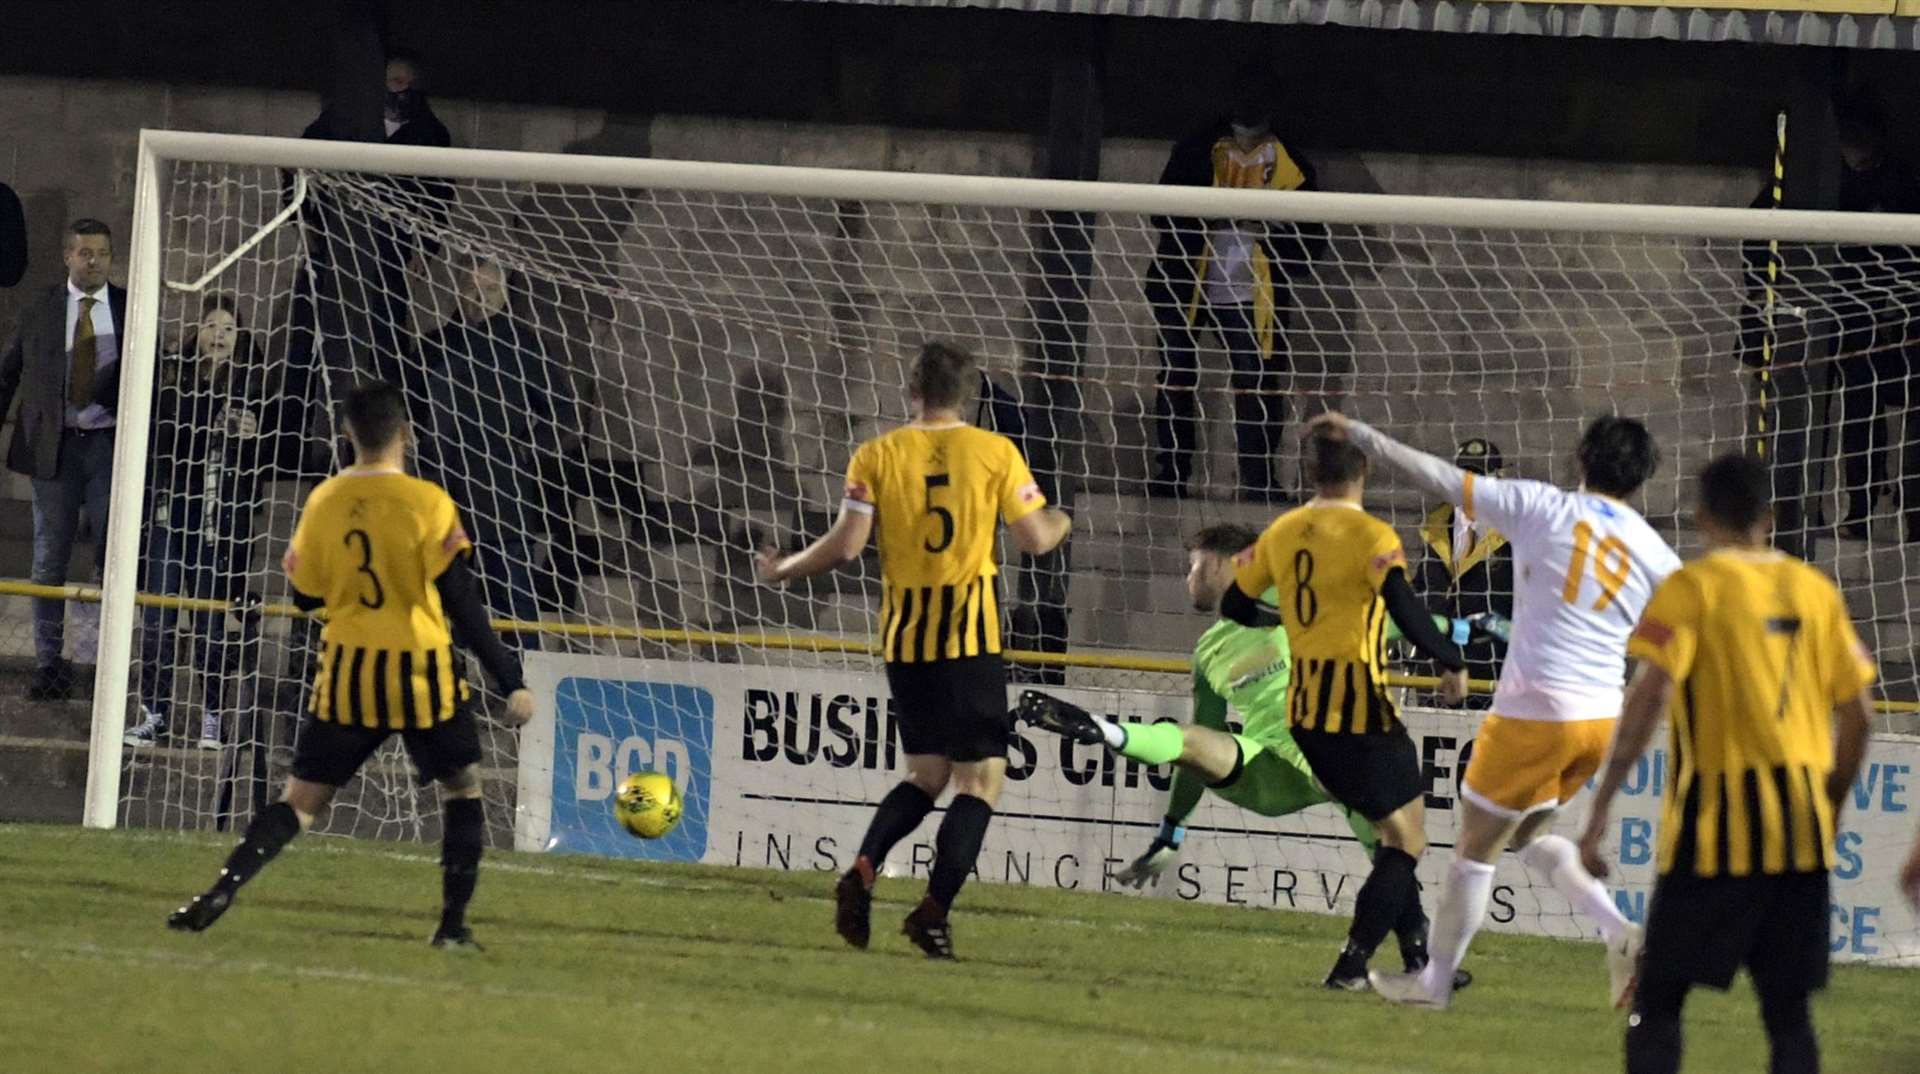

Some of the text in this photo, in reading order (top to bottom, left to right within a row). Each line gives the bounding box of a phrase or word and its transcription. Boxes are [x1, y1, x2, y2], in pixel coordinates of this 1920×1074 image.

[924, 474, 955, 554] 5
[344, 528, 385, 610] 3
[1294, 548, 1317, 628] 8
[1562, 519, 1632, 612] 19
[1766, 616, 1802, 721] 7
